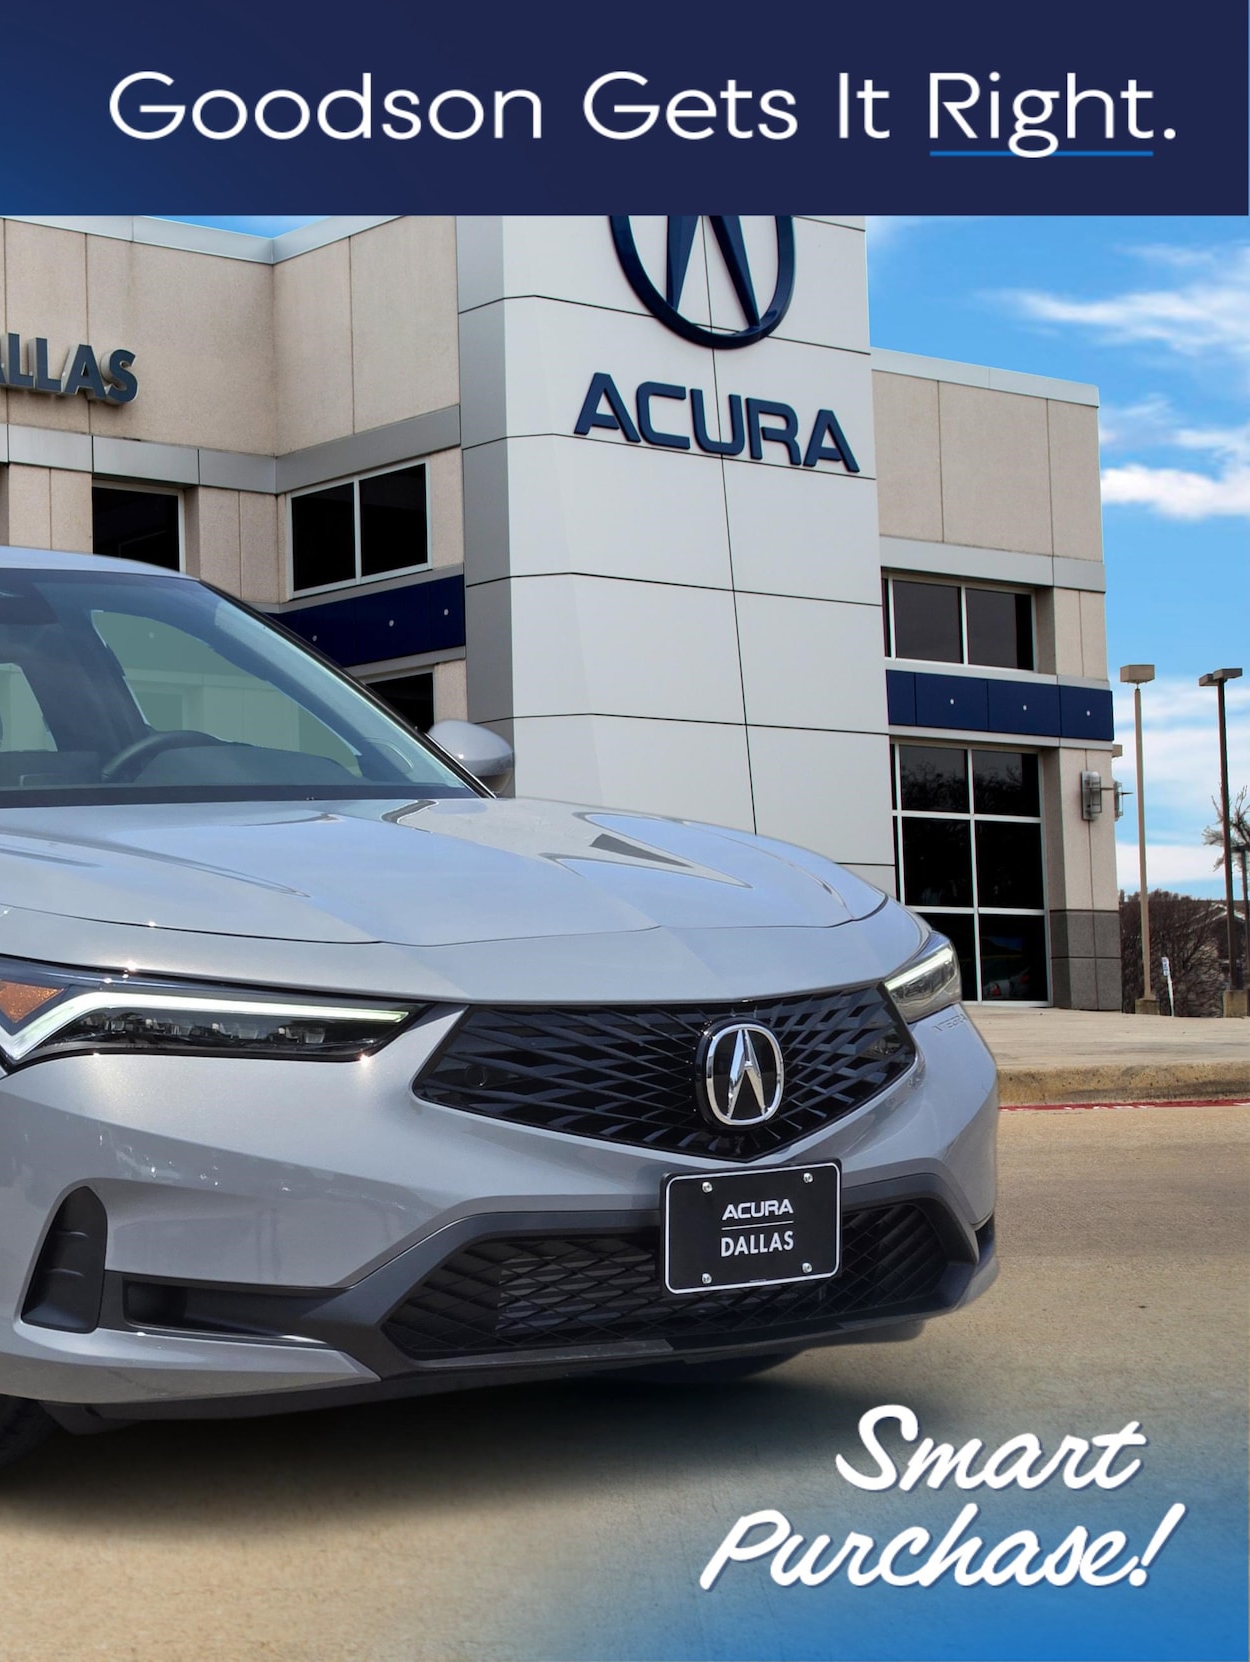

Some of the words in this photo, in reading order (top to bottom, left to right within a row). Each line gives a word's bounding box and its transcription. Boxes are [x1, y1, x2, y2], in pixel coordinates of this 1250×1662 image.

[573, 371, 861, 475] ACURA
[721, 1199, 794, 1221] ACURA
[720, 1231, 794, 1257] DALLAS
